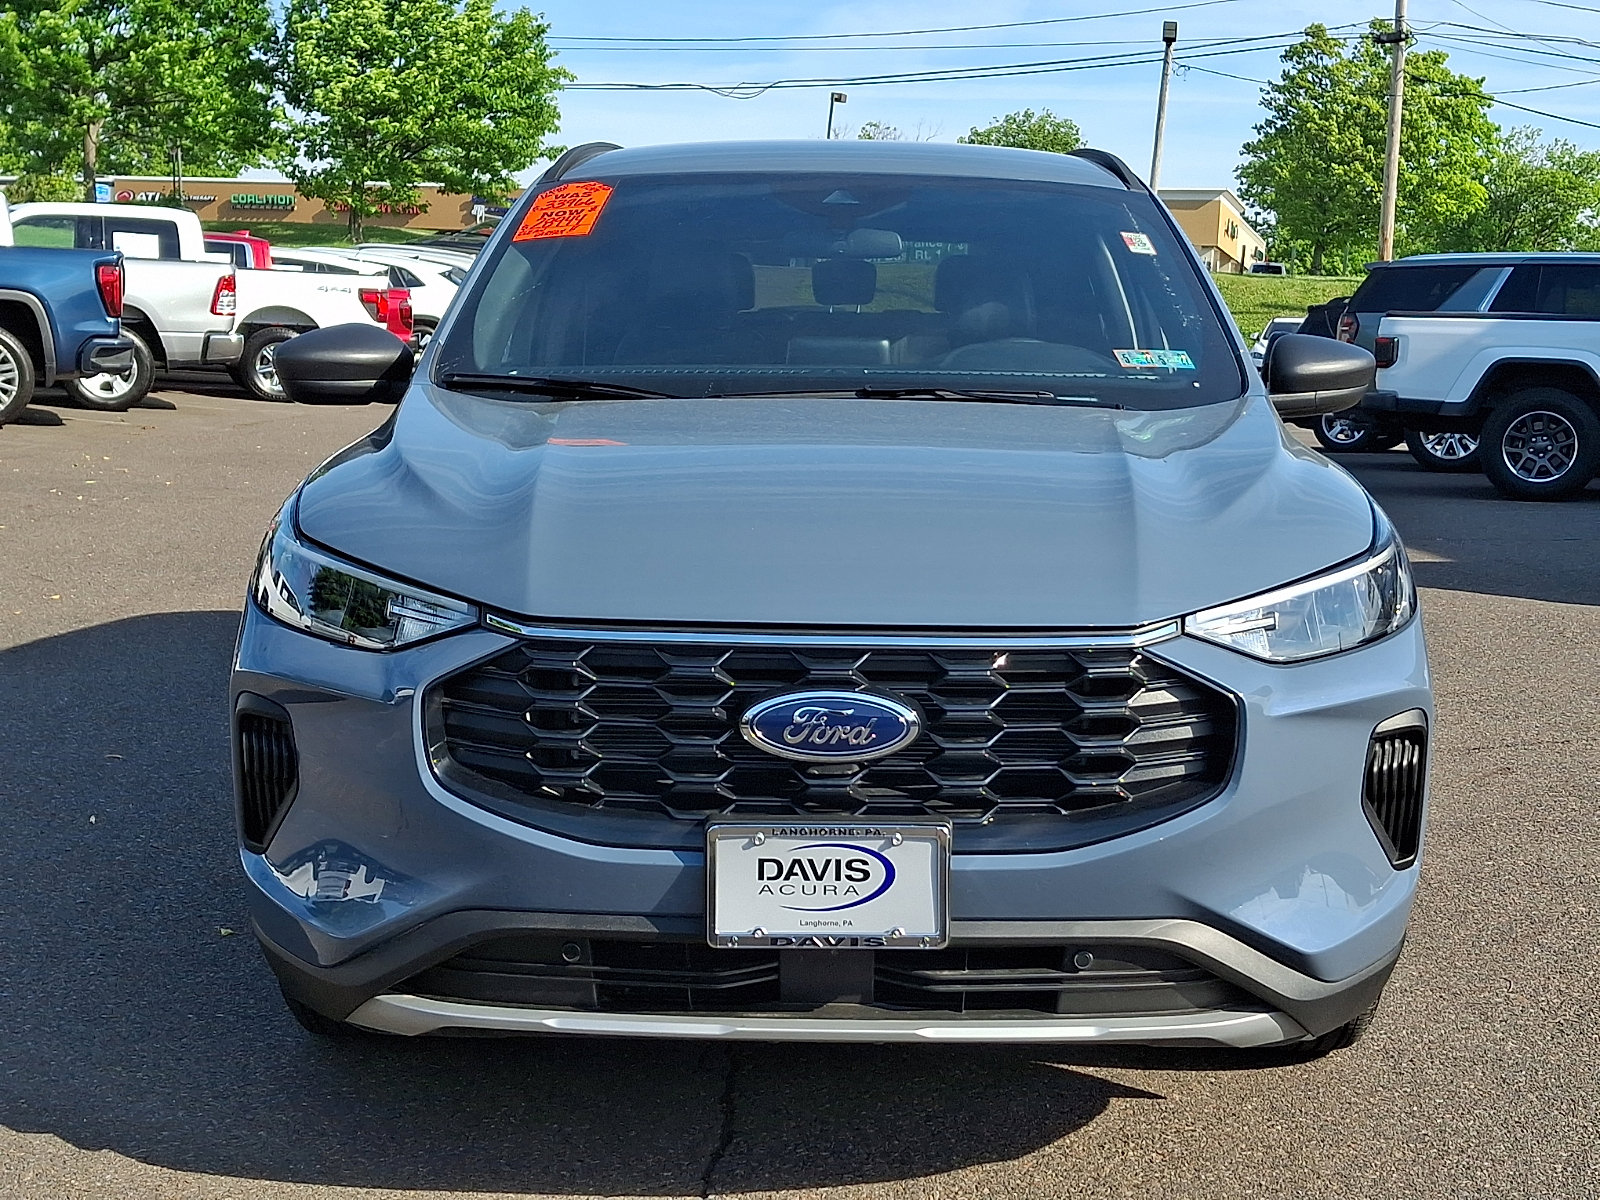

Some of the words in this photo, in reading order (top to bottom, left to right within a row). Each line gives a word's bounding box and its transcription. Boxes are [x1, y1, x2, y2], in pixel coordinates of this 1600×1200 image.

[136, 192, 161, 201] ATI
[230, 193, 296, 205] COALITION
[554, 191, 593, 199] WAS
[540, 208, 585, 218] NOW
[783, 706, 878, 745] Ford
[757, 858, 871, 882] DAVIS
[758, 884, 860, 896] ACURA
[799, 919, 841, 928] Langhorne,
[842, 919, 853, 927] PA
[769, 936, 886, 947] DAVIS
